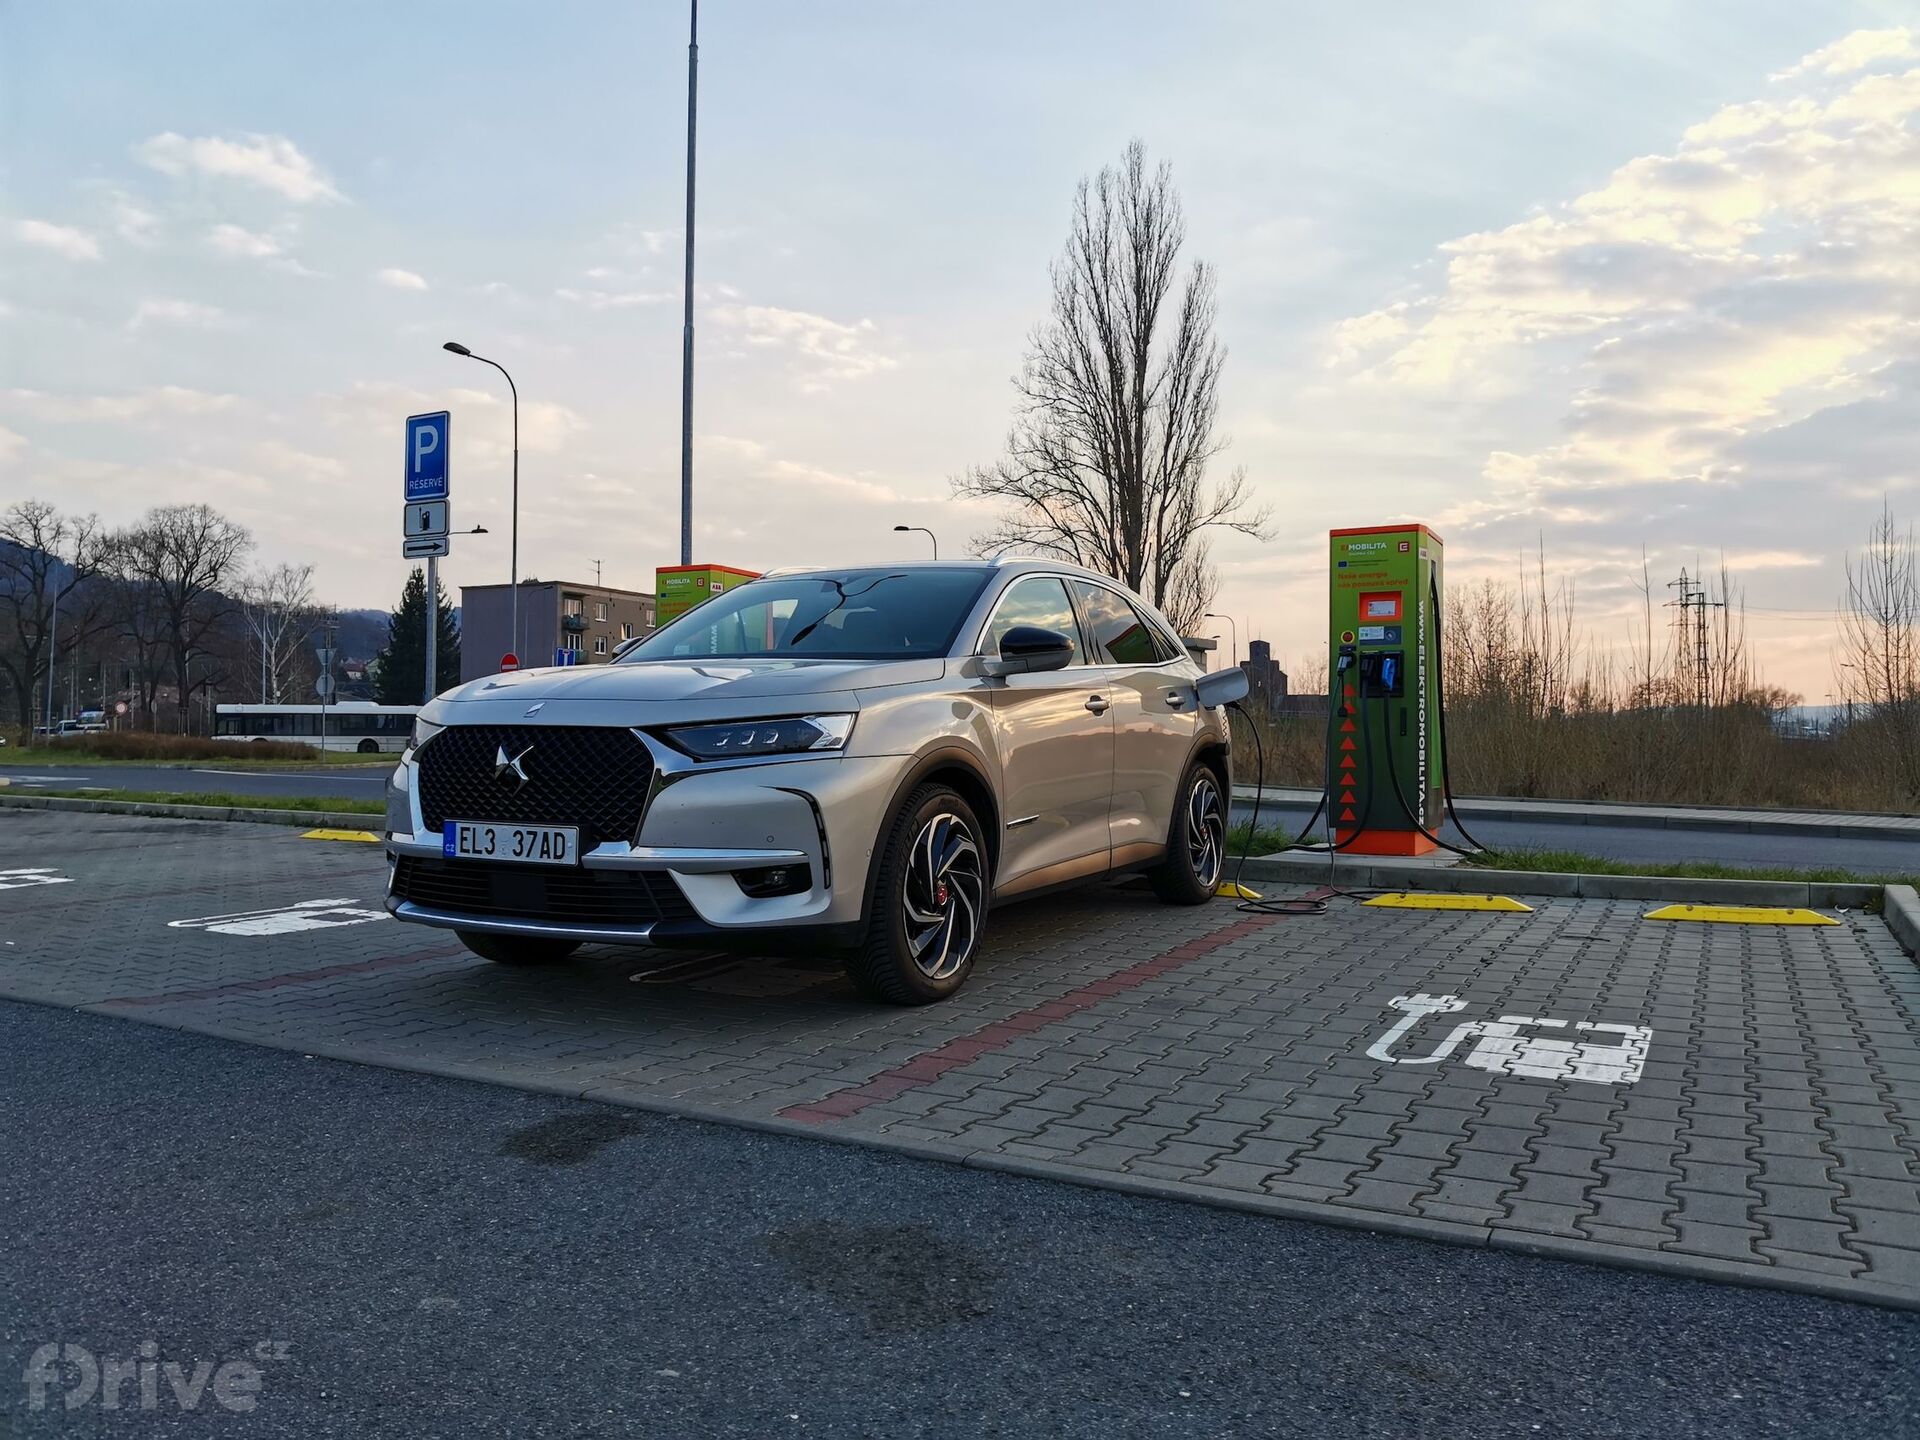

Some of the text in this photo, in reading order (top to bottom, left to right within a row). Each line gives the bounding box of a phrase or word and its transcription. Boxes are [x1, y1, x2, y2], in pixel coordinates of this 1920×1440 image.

[414, 425, 439, 473] P
[409, 476, 443, 490] RÉSERVÉ
[445, 843, 455, 852] CZ
[459, 826, 566, 860] EL3 37AD
